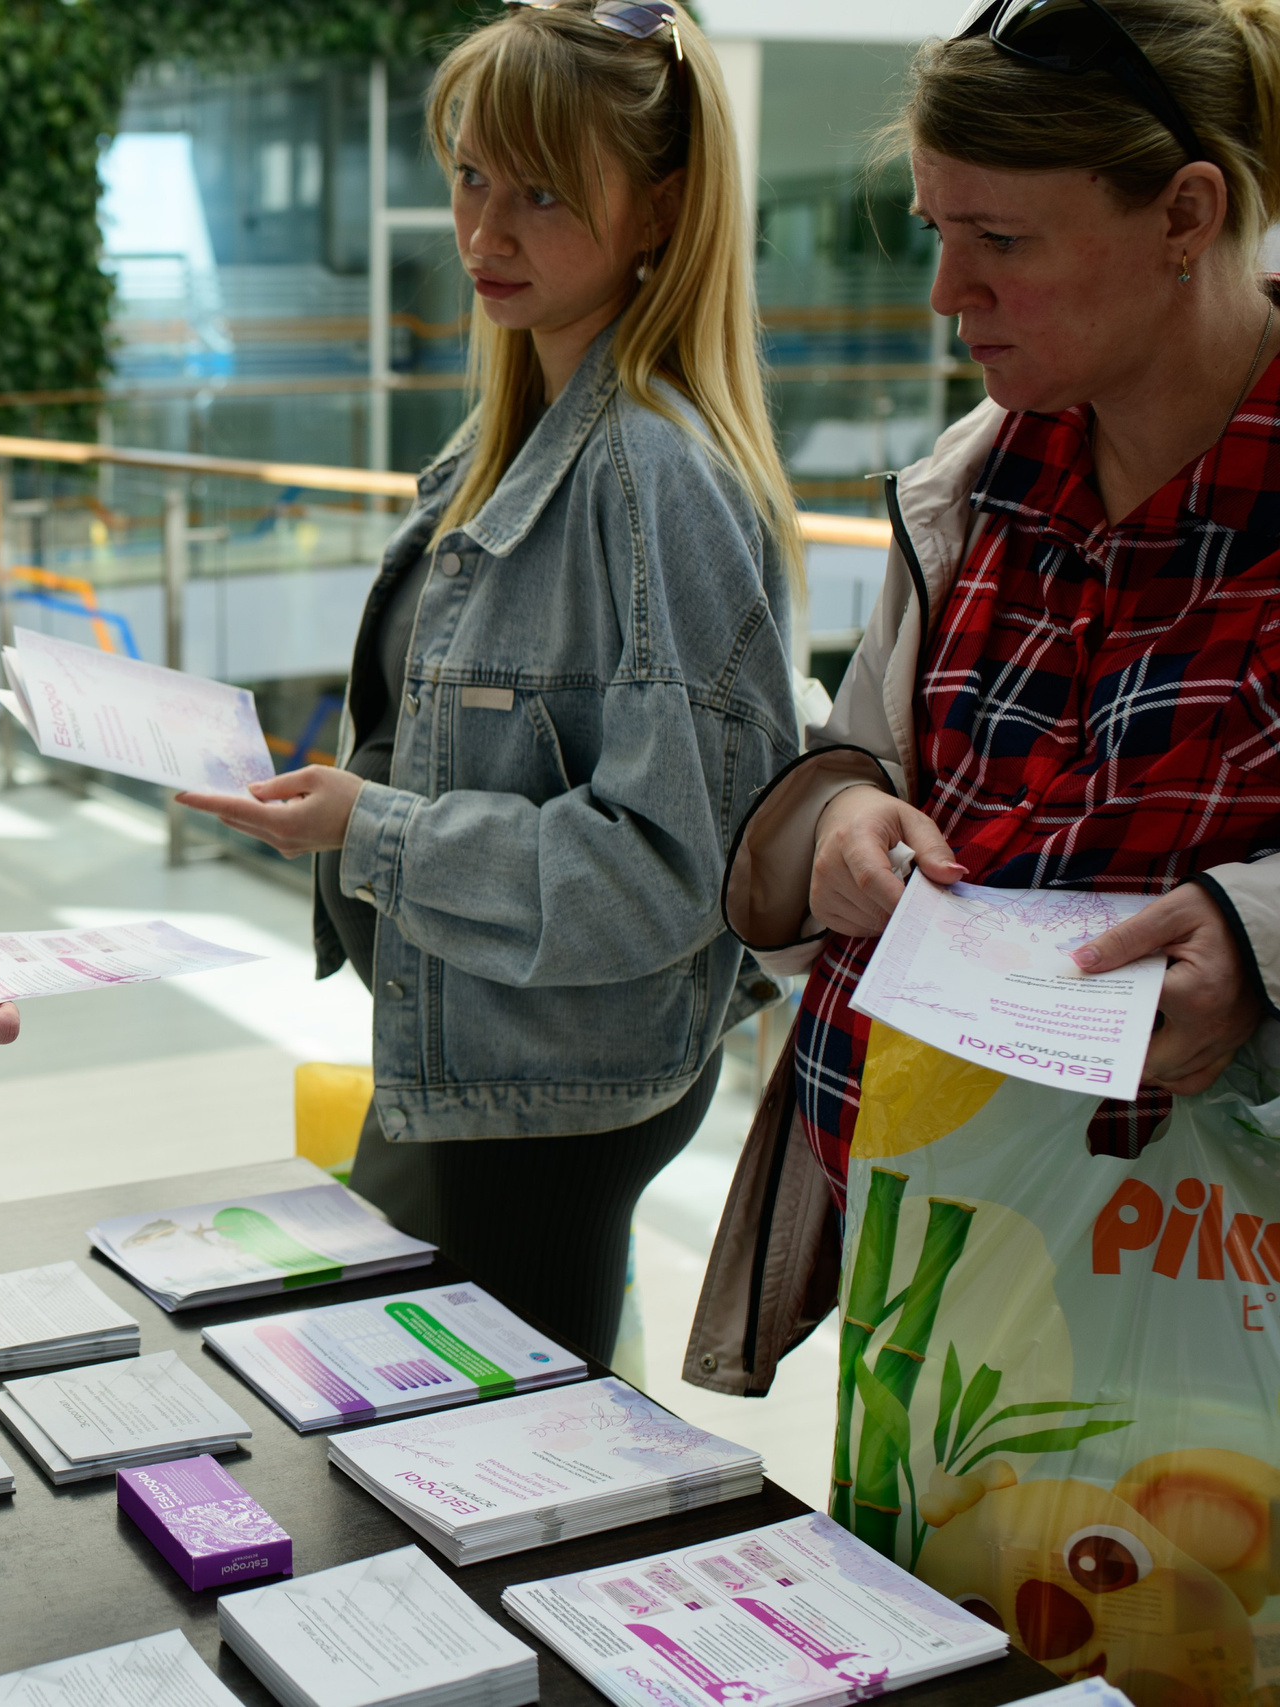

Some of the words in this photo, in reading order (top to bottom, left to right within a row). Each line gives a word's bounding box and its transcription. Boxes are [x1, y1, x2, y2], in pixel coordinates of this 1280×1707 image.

[988, 997, 1110, 1024] гиалуроновой
[988, 1005, 1123, 1035] фитокомплекса
[1054, 1002, 1127, 1015] кислоты
[1013, 1020, 1120, 1044] комбинация
[959, 1033, 1113, 1084] Estrogial
[1092, 1177, 1280, 1286] Pik
[57, 1399, 92, 1428] Эстрогиал
[130, 1470, 177, 1509] Estrogial
[391, 1470, 481, 1515] Estrogial
[220, 1557, 268, 1575] Estrogial
[614, 1664, 680, 1707] trogial
